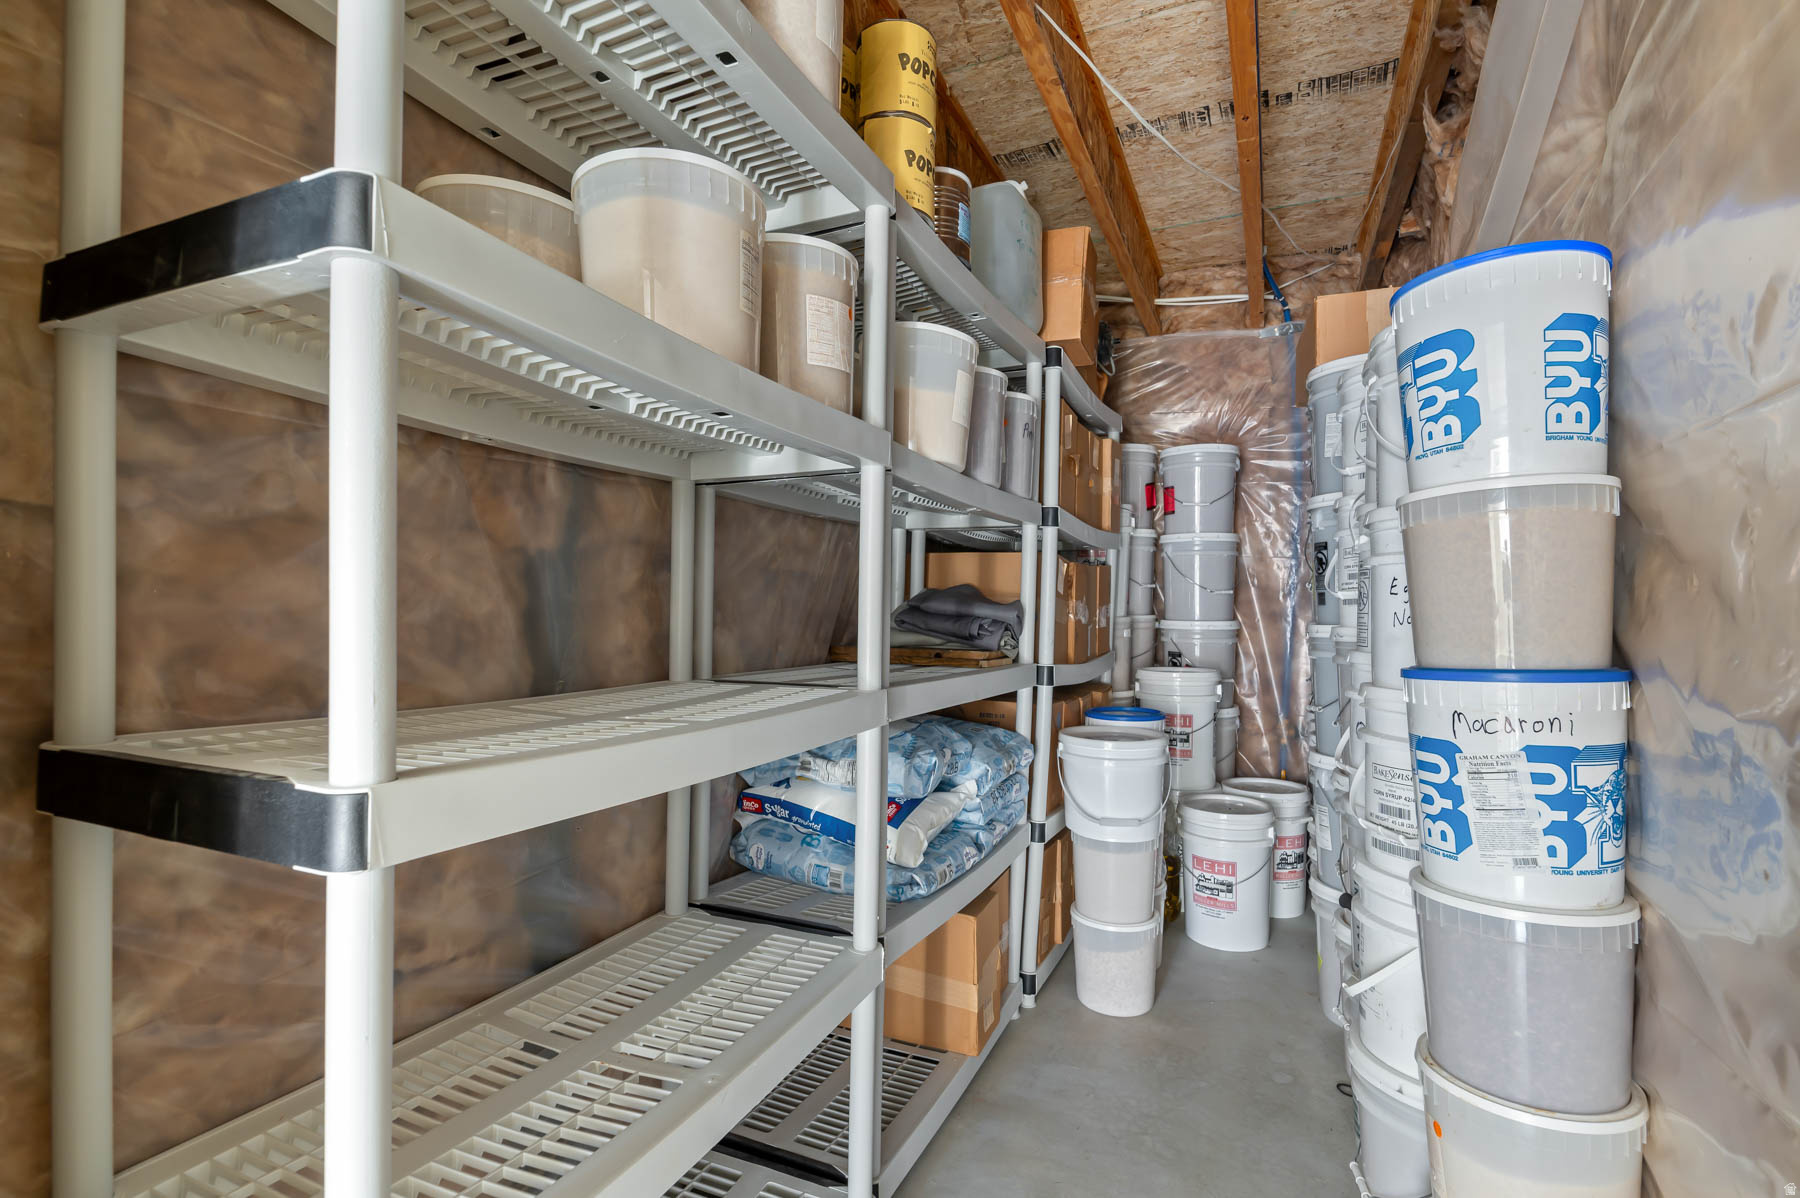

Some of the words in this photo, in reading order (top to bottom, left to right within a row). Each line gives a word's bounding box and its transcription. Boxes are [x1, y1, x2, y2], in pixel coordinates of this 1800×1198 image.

[1543, 326, 1593, 434] BYU
[1414, 345, 1465, 452] BYU
[1429, 448, 1444, 456] UTAH
[1452, 710, 1575, 739] Macaroni
[1385, 791, 1403, 801] SYRUP
[1415, 750, 1458, 854] BYU
[764, 803, 790, 818] Sugar
[1194, 857, 1232, 875] LEHI
[1577, 868, 1608, 876] UNIVERSITY
